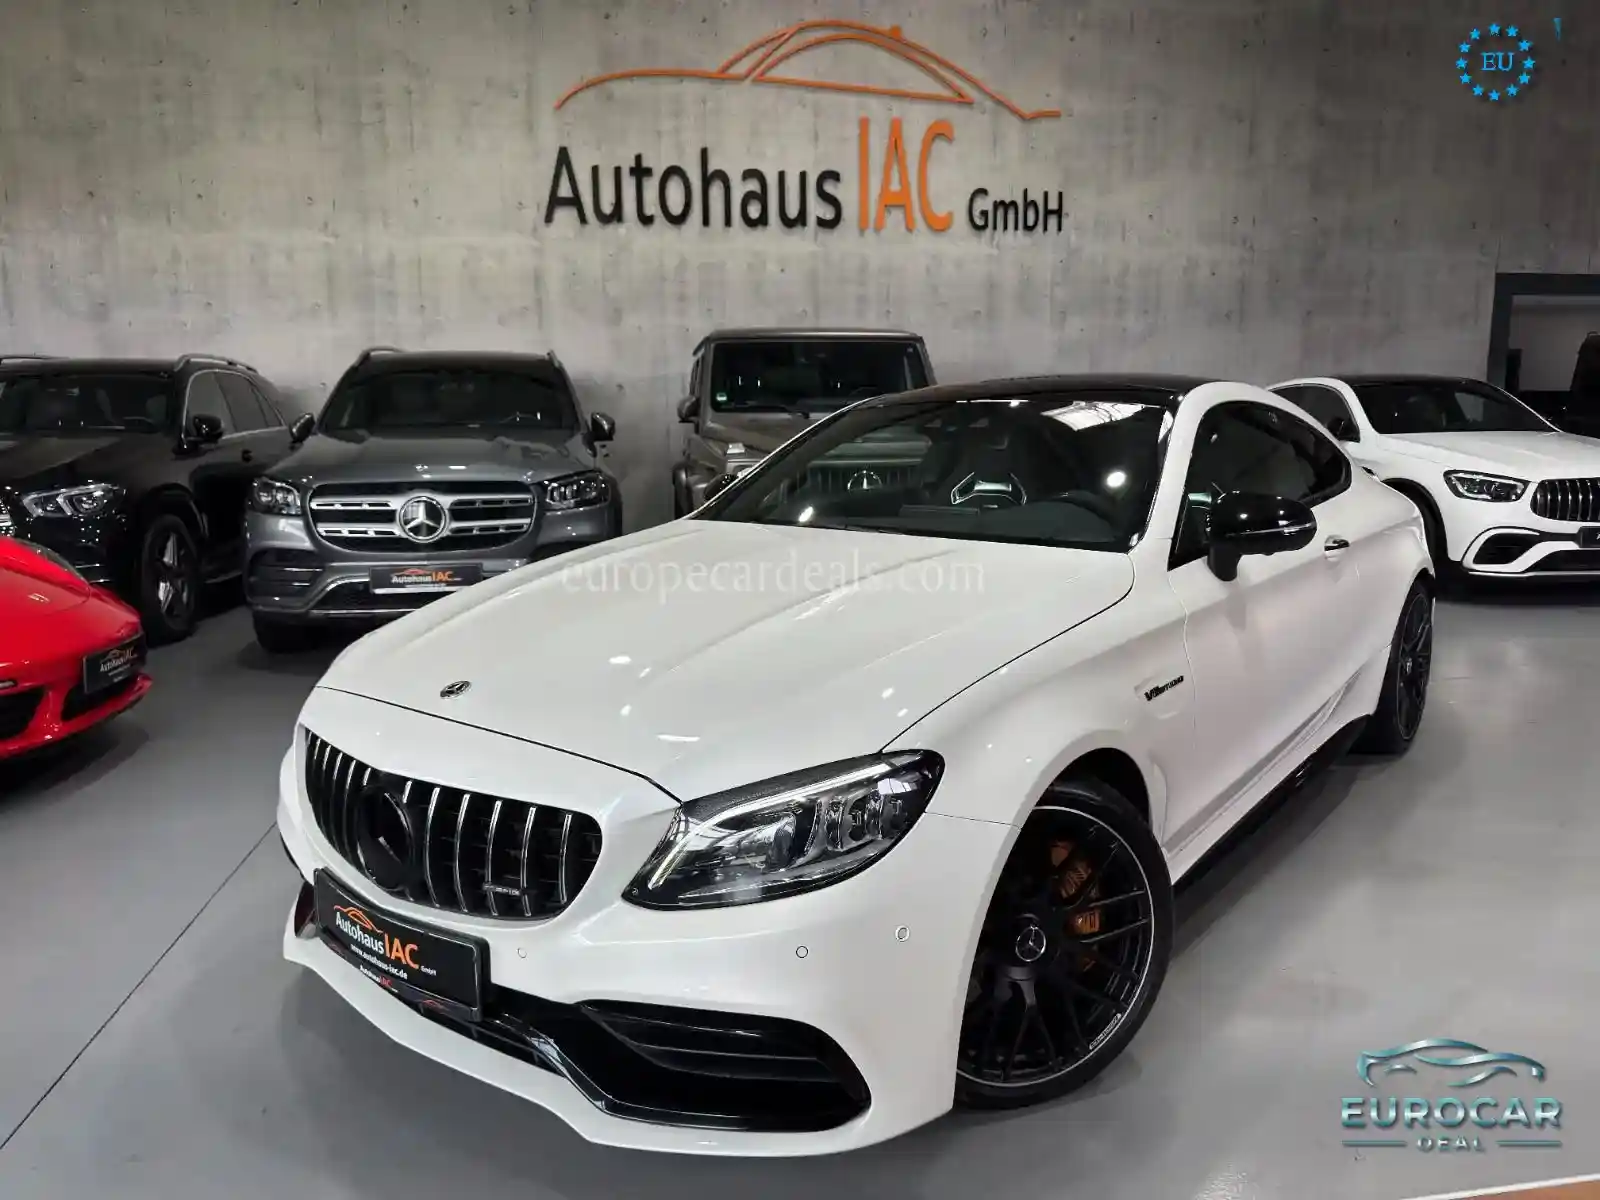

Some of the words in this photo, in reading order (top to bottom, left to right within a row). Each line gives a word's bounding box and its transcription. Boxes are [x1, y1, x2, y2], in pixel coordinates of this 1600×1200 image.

[544, 145, 842, 229] Autohaus
[858, 116, 955, 233] IAC
[967, 187, 1064, 233] GmbH
[335, 911, 385, 955] Autohaus
[384, 933, 420, 970] IAC
